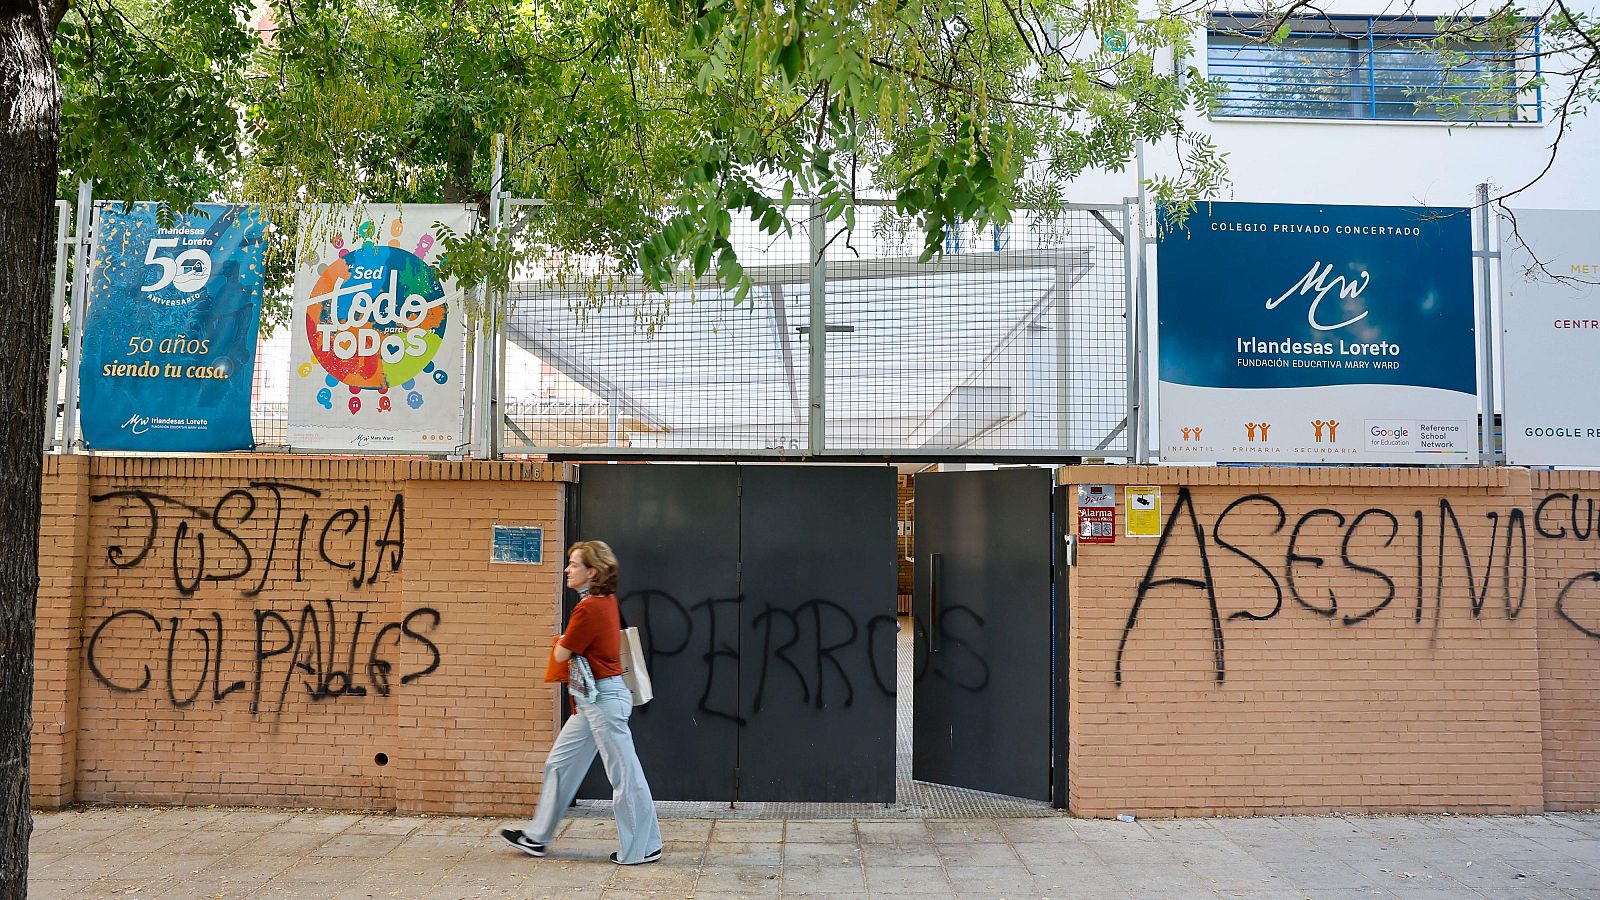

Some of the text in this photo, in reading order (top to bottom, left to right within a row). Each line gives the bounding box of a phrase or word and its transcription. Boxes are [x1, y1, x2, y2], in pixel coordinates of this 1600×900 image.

[1211, 222, 1421, 236] COLEGIO PRIVADO CONCERTADO
[182, 237, 213, 246] Loreto
[141, 237, 212, 293] 50
[147, 293, 201, 307] ANIVERSARIO
[303, 269, 464, 331] todo
[384, 326, 404, 334] para
[126, 335, 210, 356] 50 años
[1237, 337, 1400, 356] Irlandesas Loreto
[103, 360, 229, 379] siendo tu casa.
[1237, 358, 1400, 370] FUNDACIÓN EDUCATIVA MARY WARD
[151, 417, 185, 425] Irlandesas
[1420, 424, 1459, 432] Reference
[1370, 426, 1409, 439] Google
[1420, 432, 1446, 440] School
[1525, 428, 1581, 437] GOOGLE
[1078, 508, 1113, 517] Alarma
[1534, 492, 1600, 541] CU
[92, 481, 405, 598] JUSTICIA
[1115, 486, 1529, 688] ASESINO
[620, 589, 991, 729] PERROS
